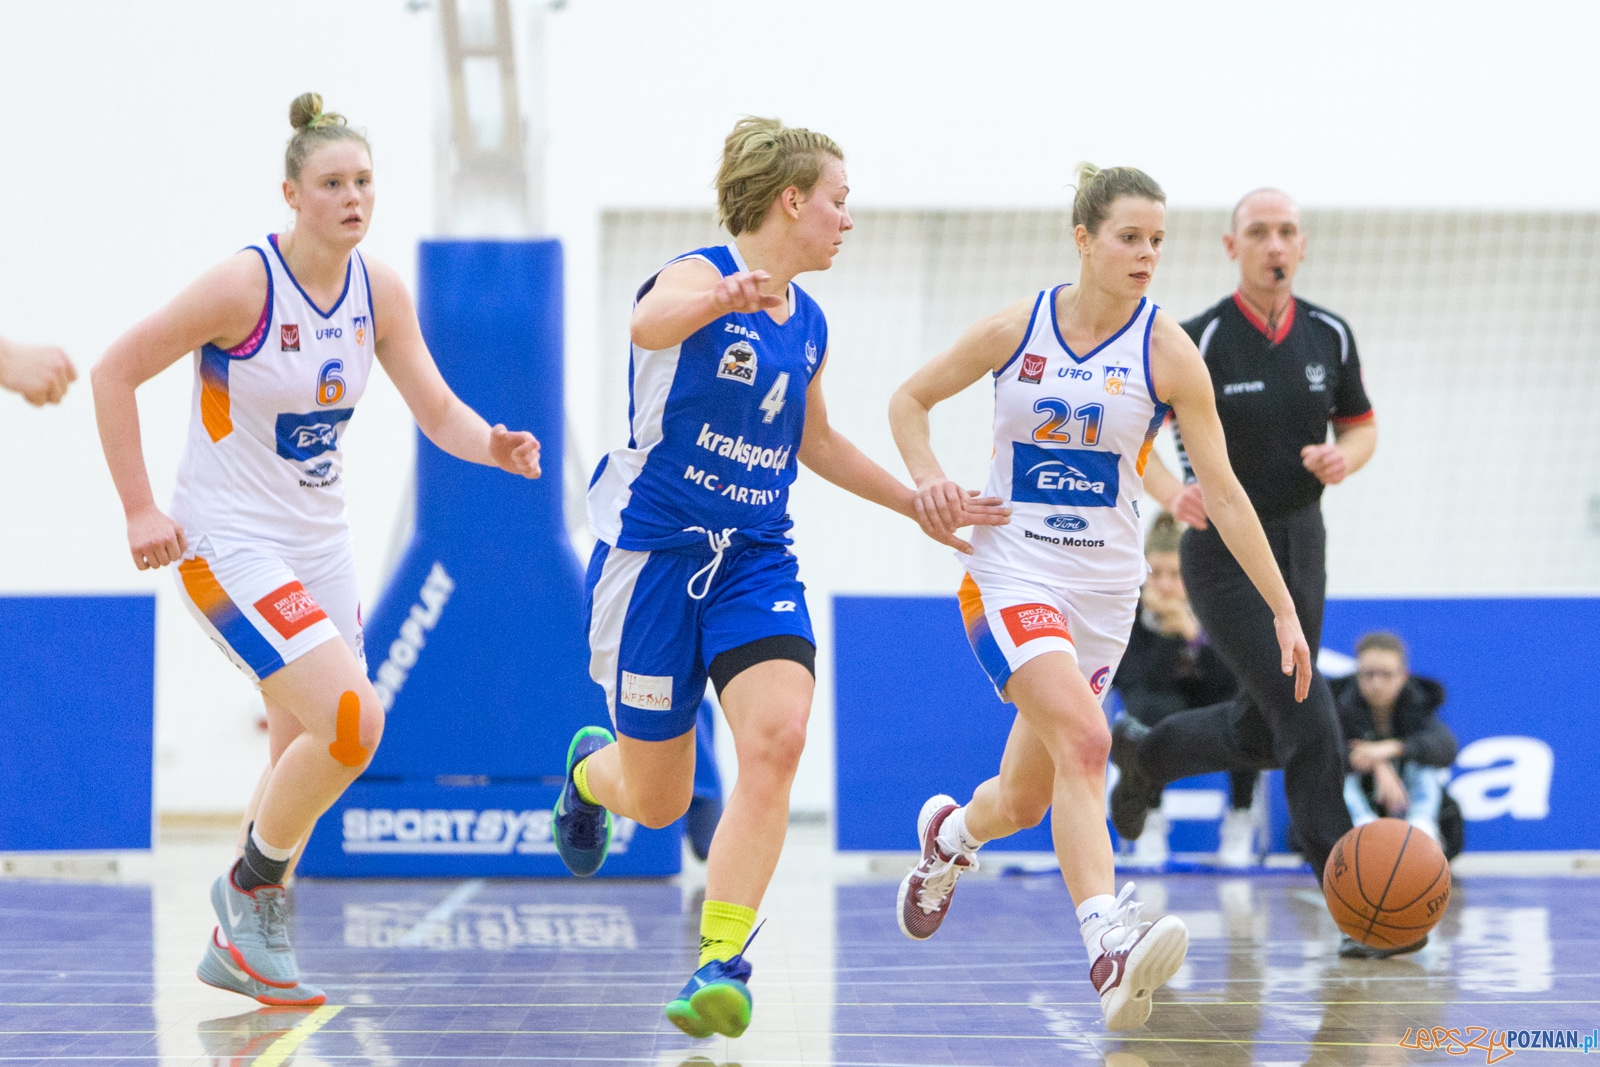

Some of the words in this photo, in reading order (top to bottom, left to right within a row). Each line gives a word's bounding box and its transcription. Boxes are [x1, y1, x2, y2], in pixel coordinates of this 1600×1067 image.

[316, 358, 346, 406] 6
[759, 371, 790, 424] 4
[1032, 397, 1105, 446] 21
[1037, 470, 1105, 494] Enea
[1024, 530, 1060, 545] Bemo
[1062, 536, 1105, 548] Motors
